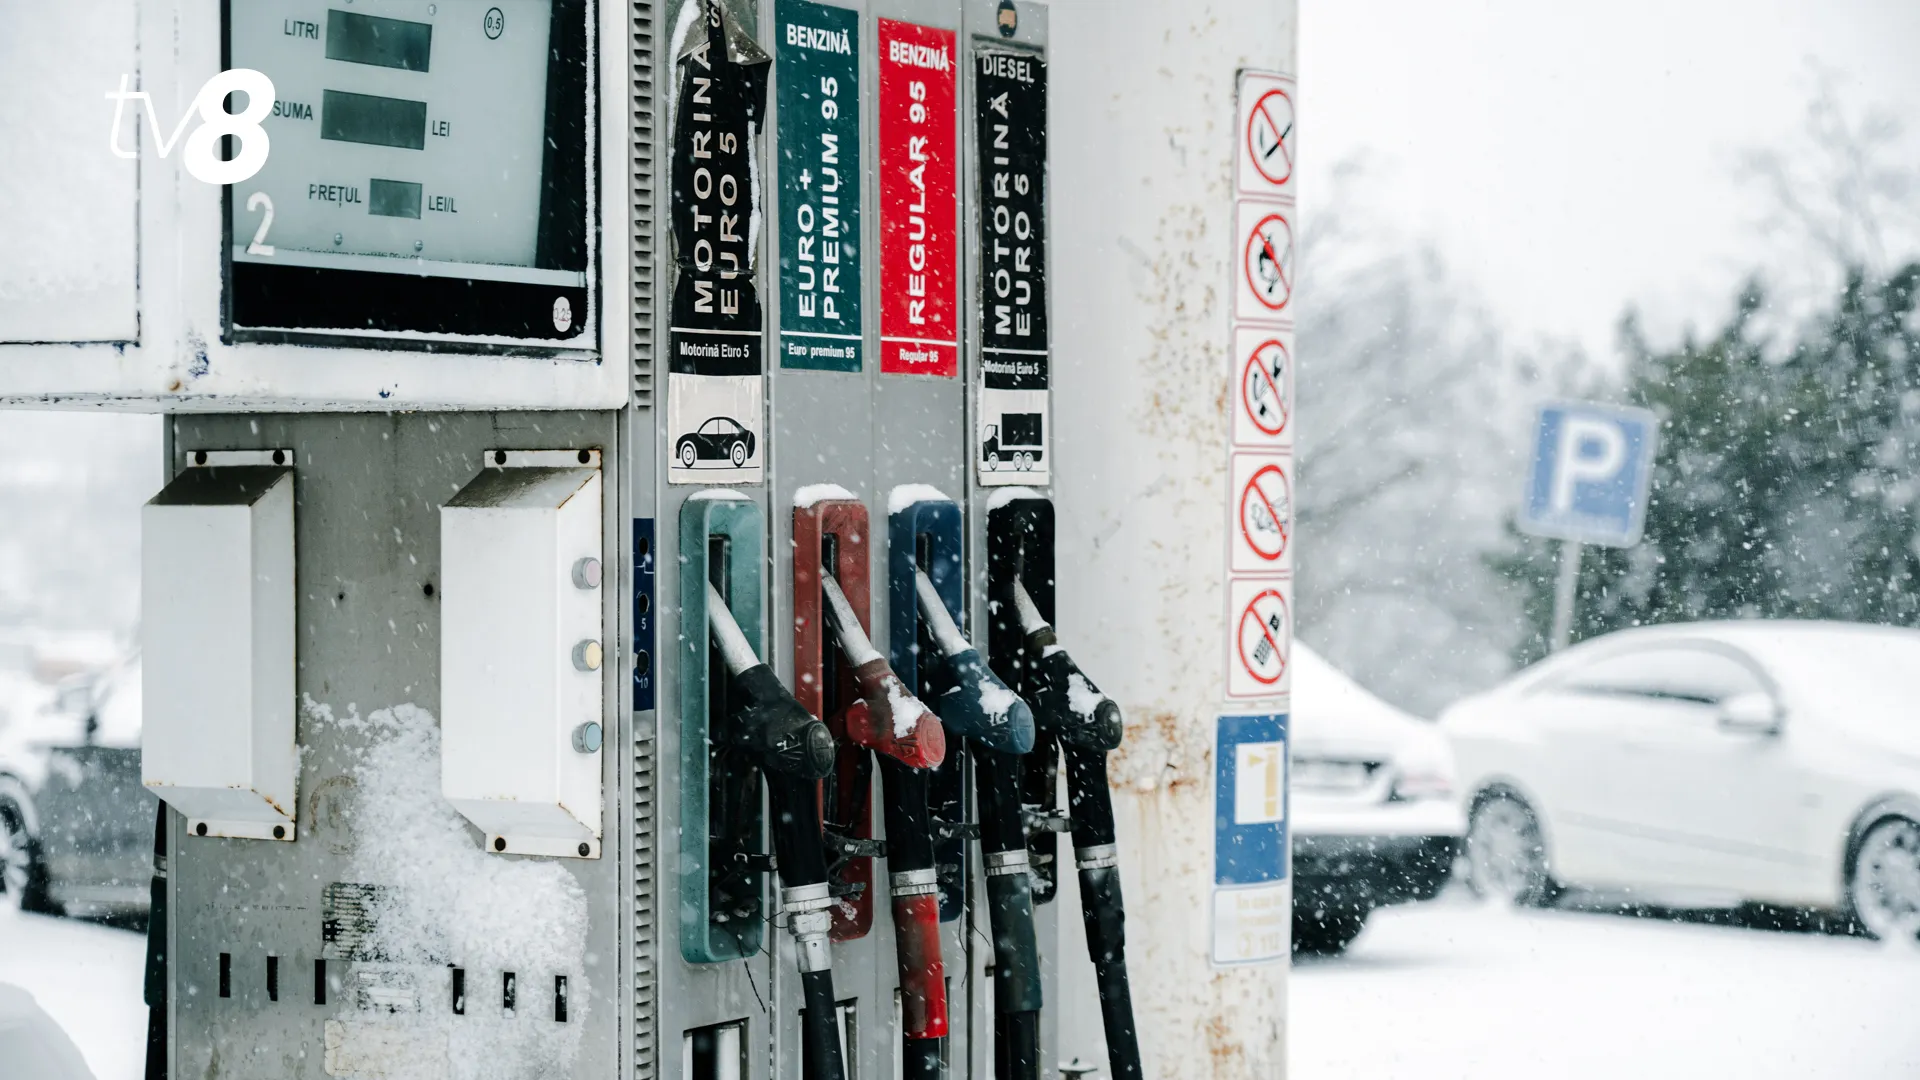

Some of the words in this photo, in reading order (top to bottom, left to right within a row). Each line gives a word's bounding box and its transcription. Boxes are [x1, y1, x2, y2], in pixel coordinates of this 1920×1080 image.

[284, 19, 319, 40] LITRI
[486, 15, 502, 31] 0,5
[787, 23, 851, 56] BENZINĂ
[889, 40, 950, 72] BENZINĂ
[983, 55, 1035, 83] DIESEL
[273, 100, 314, 121] SUMA
[821, 76, 838, 120] 95
[909, 80, 926, 124] 95
[432, 120, 450, 137] LEI
[719, 132, 737, 155] 5
[799, 168, 812, 190] +
[1014, 173, 1029, 196] 5
[428, 195, 458, 213] LEI/L
[990, 91, 1011, 335] MOTORINĂ
[246, 191, 275, 256] 2
[821, 133, 840, 320] PREMIUM
[909, 135, 927, 325] REGULAR
[719, 173, 738, 315] EURO
[798, 203, 815, 318] EURO
[1014, 211, 1031, 336] EURO
[680, 341, 719, 358] Motorină
[721, 343, 742, 358] Euro
[743, 344, 750, 358] 5
[788, 342, 807, 356] Euro
[810, 345, 844, 359] premium
[845, 346, 856, 359] 95
[899, 348, 928, 364] Regular
[929, 350, 939, 363] 95
[1016, 361, 1033, 375] Euro
[1034, 362, 1039, 375] 5
[1551, 415, 1627, 513] P
[641, 618, 647, 630] 5
